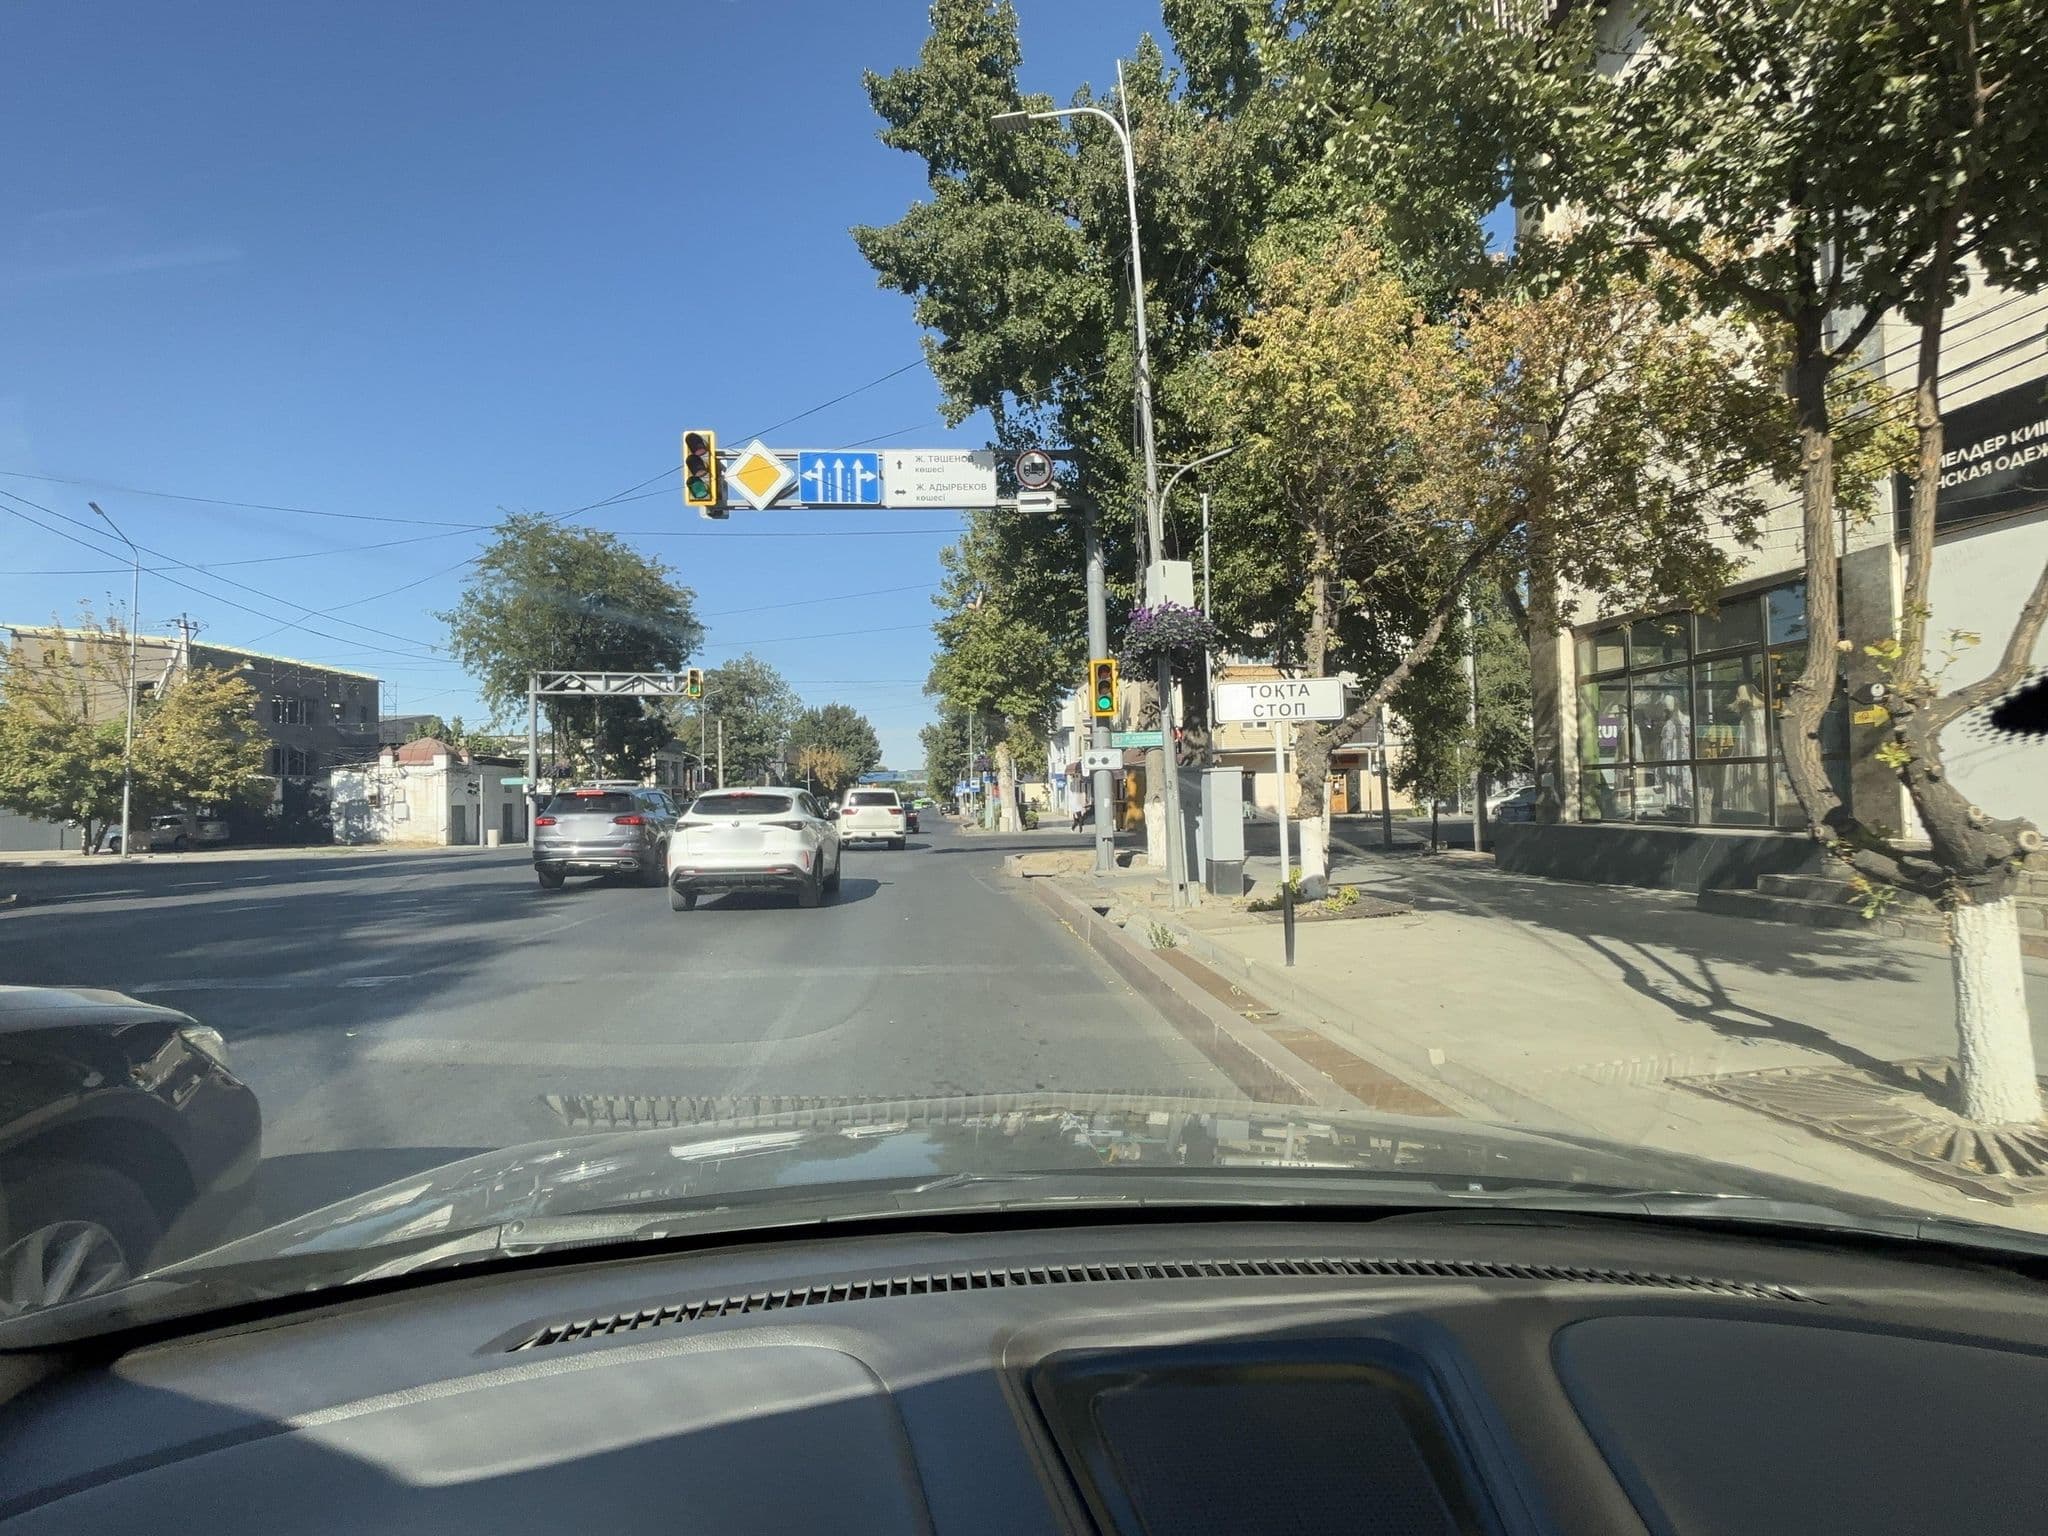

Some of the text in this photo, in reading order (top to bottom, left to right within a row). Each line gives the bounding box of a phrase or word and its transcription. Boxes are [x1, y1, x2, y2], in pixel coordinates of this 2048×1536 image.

[929, 483, 987, 491] АДЫРБЕКОВ
[1247, 683, 1310, 699] ТОҚТА
[1253, 703, 1306, 717] СТОП
